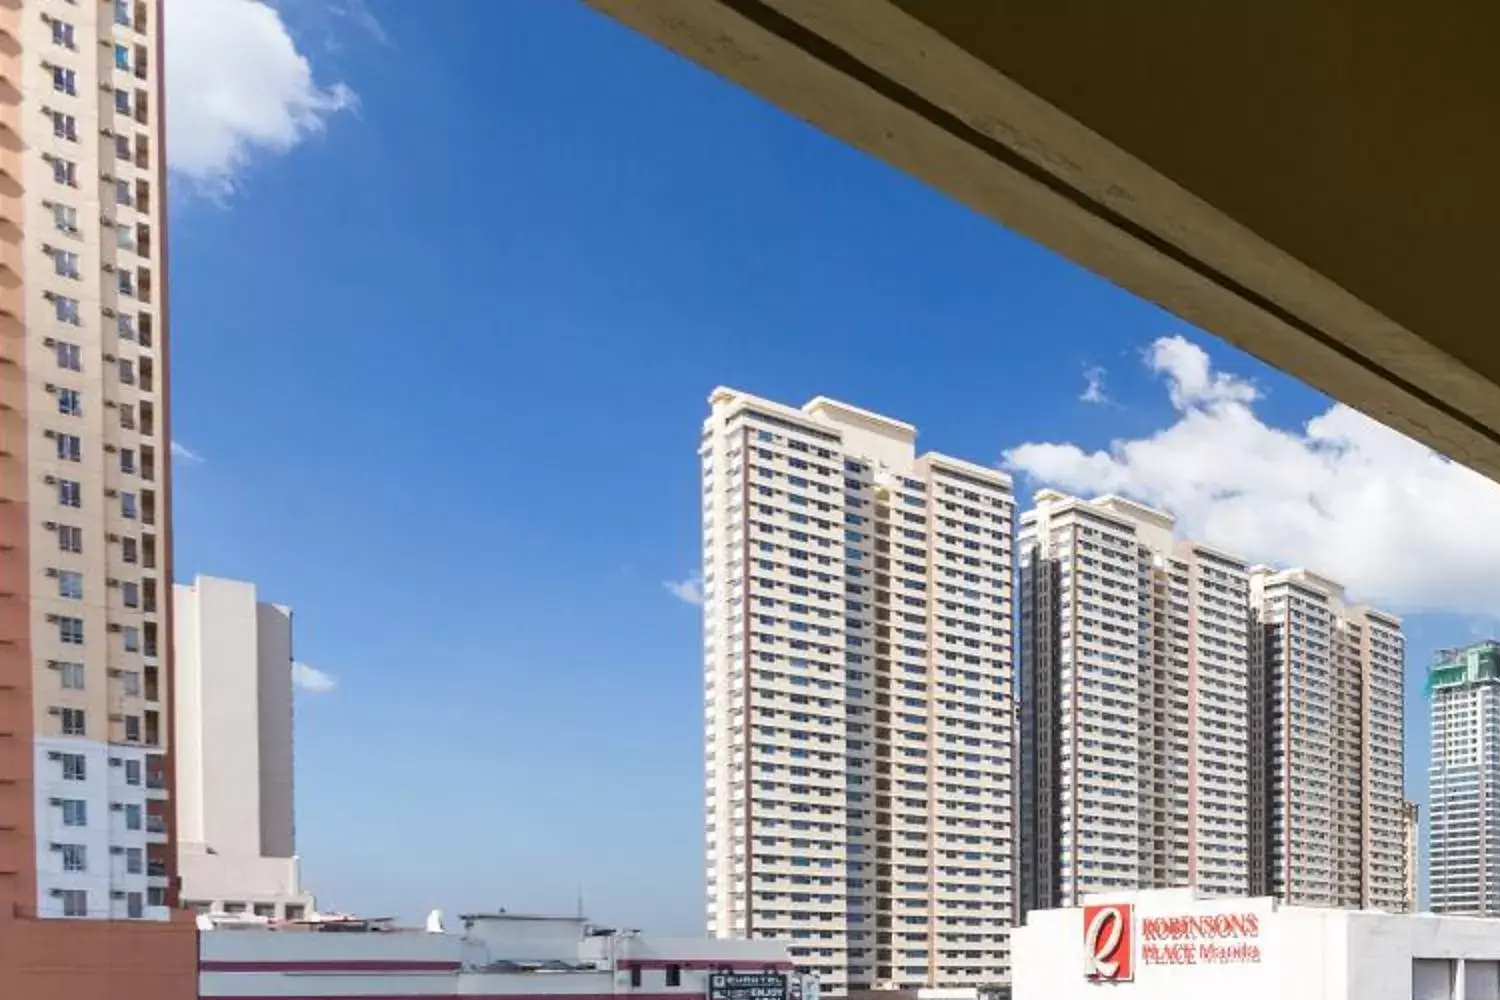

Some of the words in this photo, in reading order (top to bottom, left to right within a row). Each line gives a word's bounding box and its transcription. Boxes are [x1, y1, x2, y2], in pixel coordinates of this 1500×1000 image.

[1142, 914, 1259, 938] ROBINSONS
[1142, 944, 1196, 962] PLACE
[1199, 943, 1260, 961] Manila
